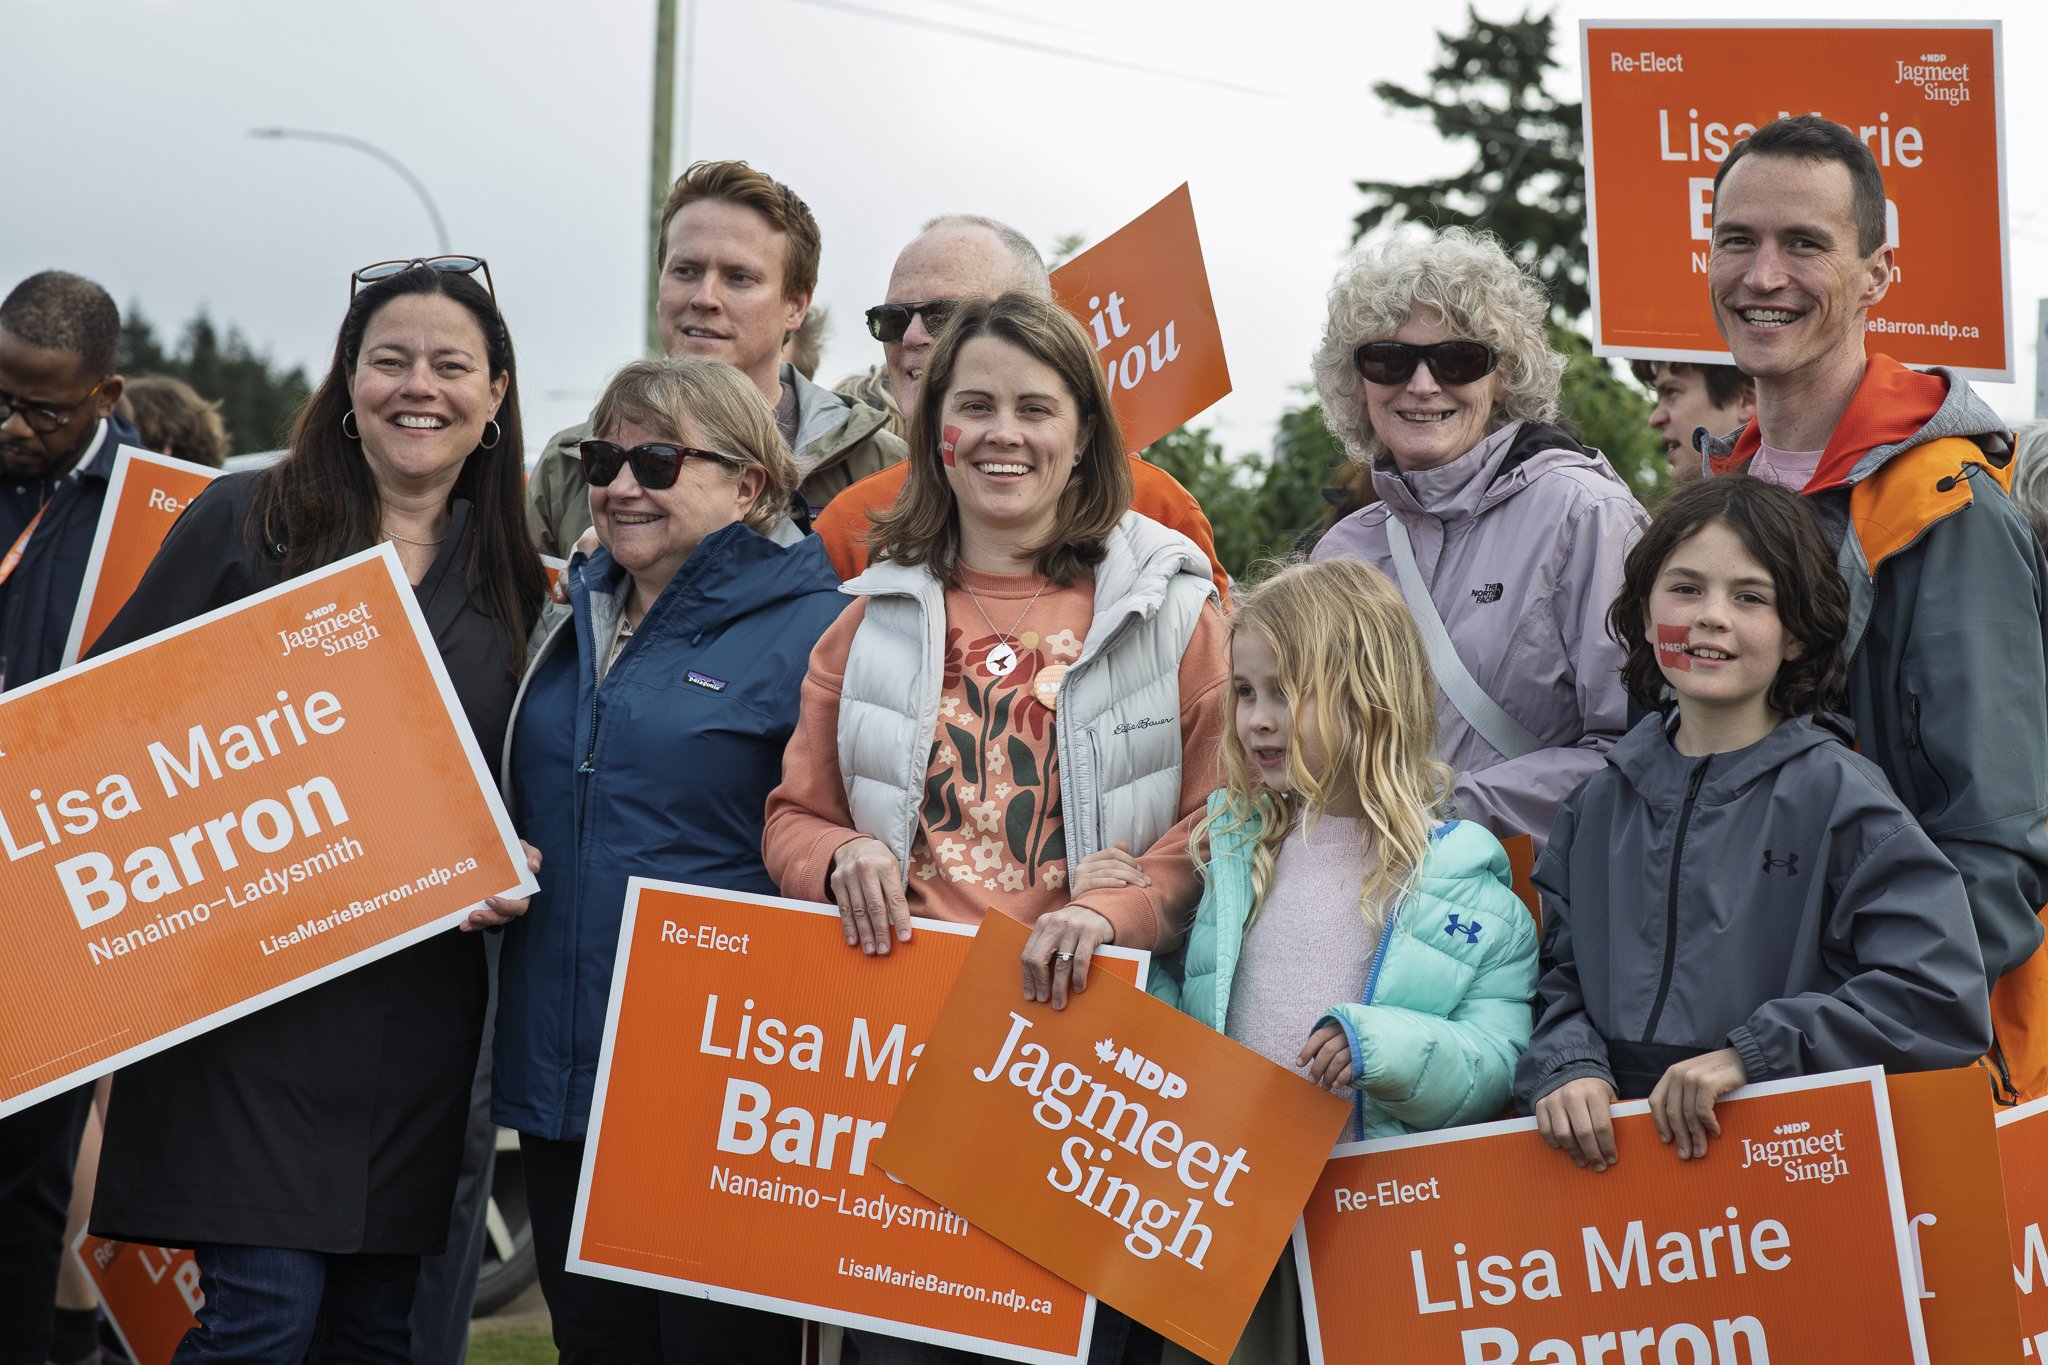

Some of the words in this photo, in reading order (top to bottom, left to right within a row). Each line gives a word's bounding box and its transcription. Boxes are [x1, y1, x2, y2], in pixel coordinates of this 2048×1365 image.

[1611, 52, 1684, 73] Re-Elect
[1894, 60, 1970, 87] Jagmeet
[1926, 53, 1947, 62] NDP
[1924, 82, 1970, 107] Singh
[1089, 290, 1131, 352] it
[1476, 596, 1495, 604] FACE
[1485, 583, 1497, 591] THE
[277, 601, 372, 656] Jagmeet
[312, 602, 337, 619] NDP
[321, 621, 381, 657] Singh
[688, 676, 721, 691] patagonia
[0, 773, 141, 862] Lisa
[147, 688, 346, 797] Marie
[54, 775, 350, 930] Barron
[259, 857, 478, 956] LisaMarieBarron.ndp.ca
[661, 920, 750, 955] Re-Elect
[699, 993, 824, 1073] Lisa
[1113, 1046, 1188, 1099] NDP
[973, 1010, 1251, 1207] Jagmeet
[1782, 1121, 1811, 1135] NDP
[1741, 1128, 1846, 1169] Jagmeet
[1783, 1153, 1849, 1184] Singh
[1046, 1136, 1213, 1271] Singh
[1334, 1177, 1441, 1213] Re-Elect
[1410, 1242, 1563, 1315] Lisa
[1581, 1206, 1792, 1293] Marie
[838, 1258, 1052, 1315] LisaMarieBarron.ndp.ca
